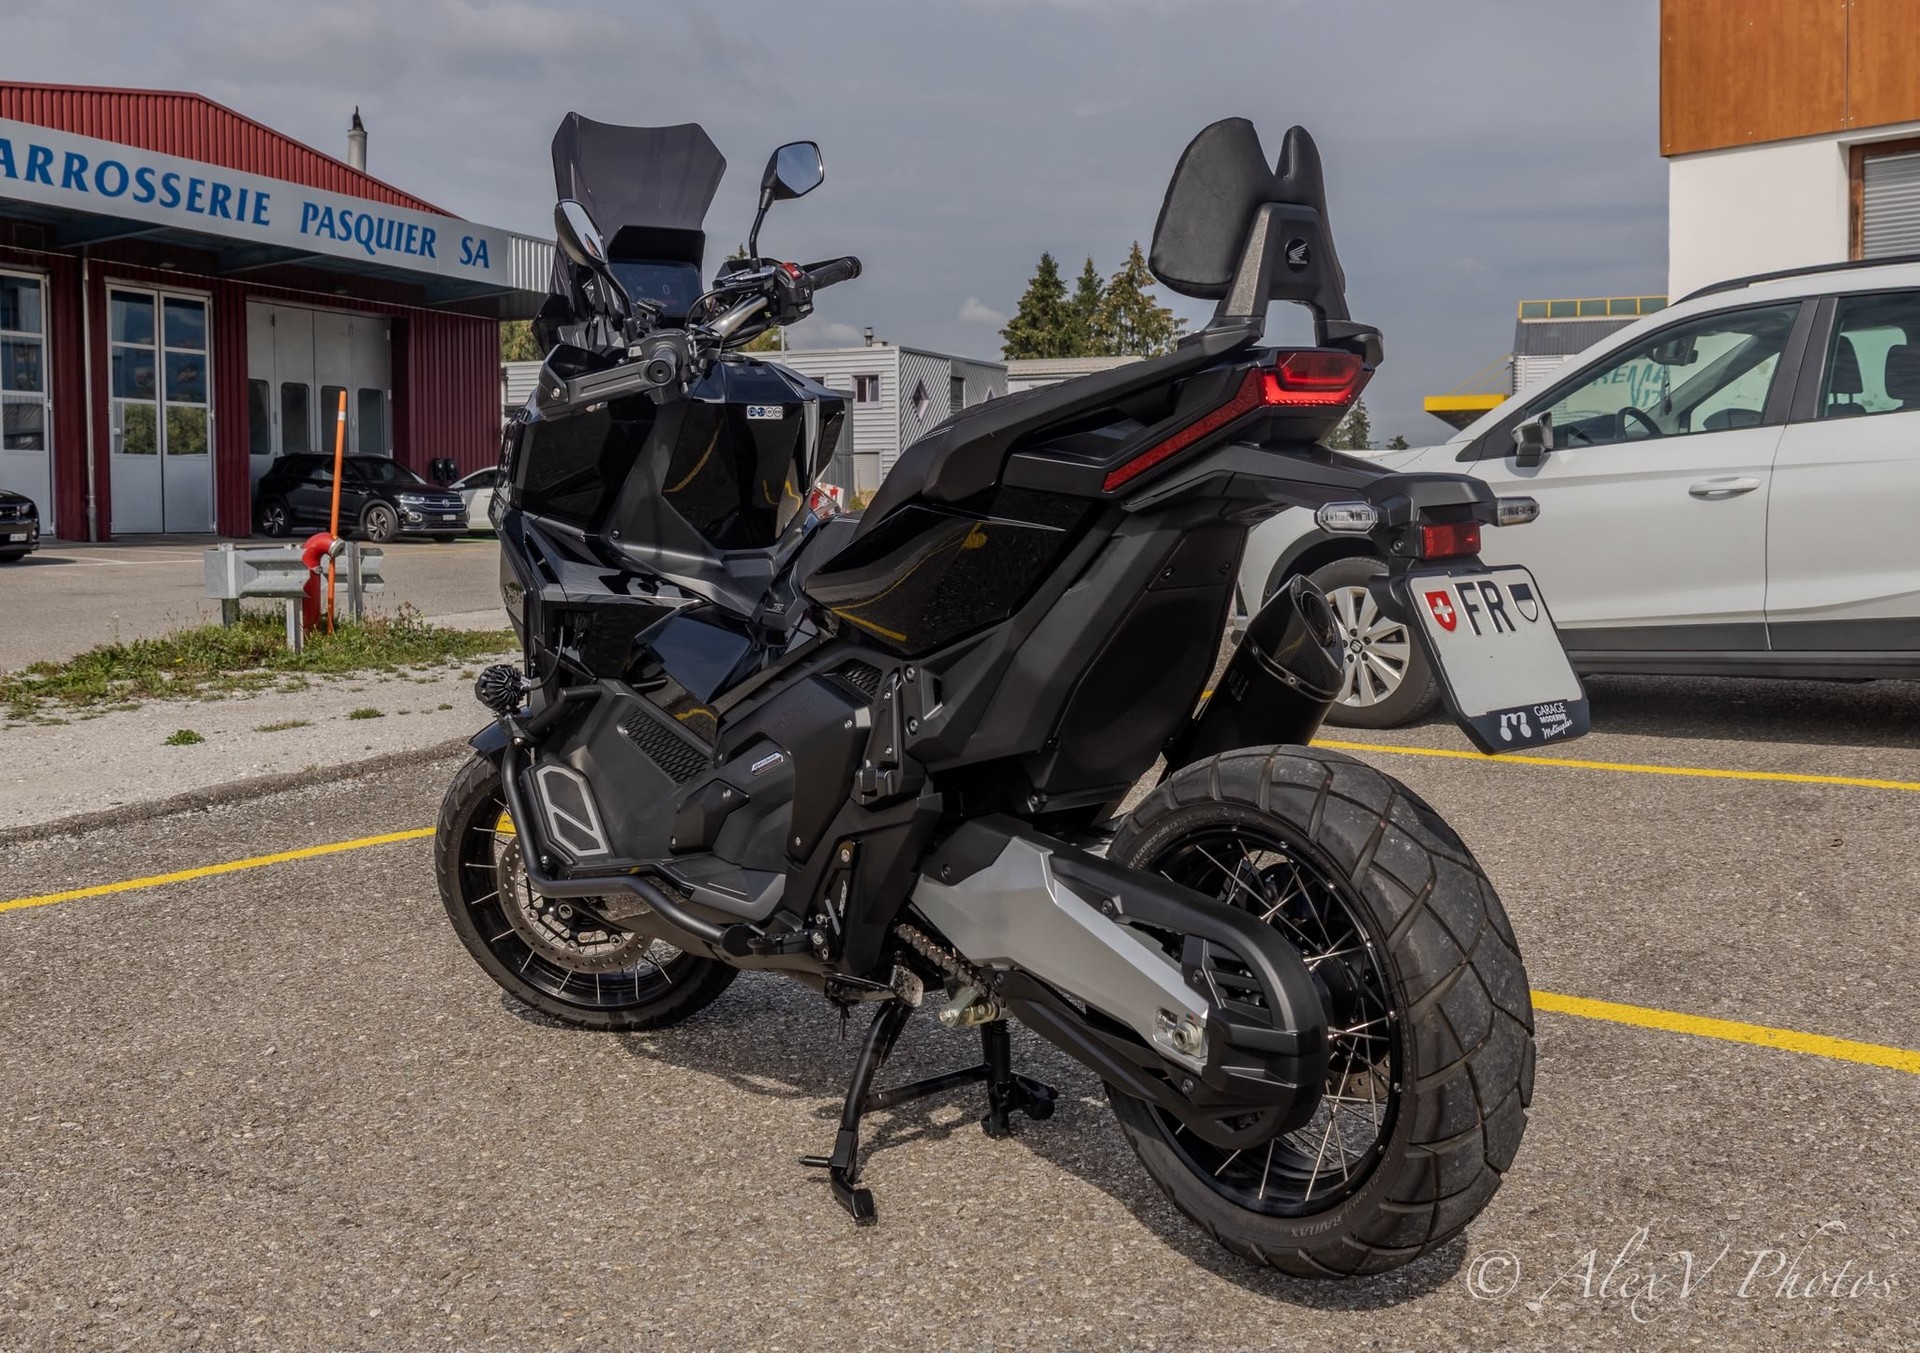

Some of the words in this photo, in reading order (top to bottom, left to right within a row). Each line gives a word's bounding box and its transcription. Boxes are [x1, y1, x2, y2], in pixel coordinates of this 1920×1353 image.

[0, 138, 270, 225] ARROSSERIE
[300, 202, 436, 255] PASQUIER
[460, 236, 490, 269] SA
[1455, 580, 1516, 635] FR
[1534, 702, 1567, 719] GARAGE
[1540, 713, 1568, 724] MODERNE
